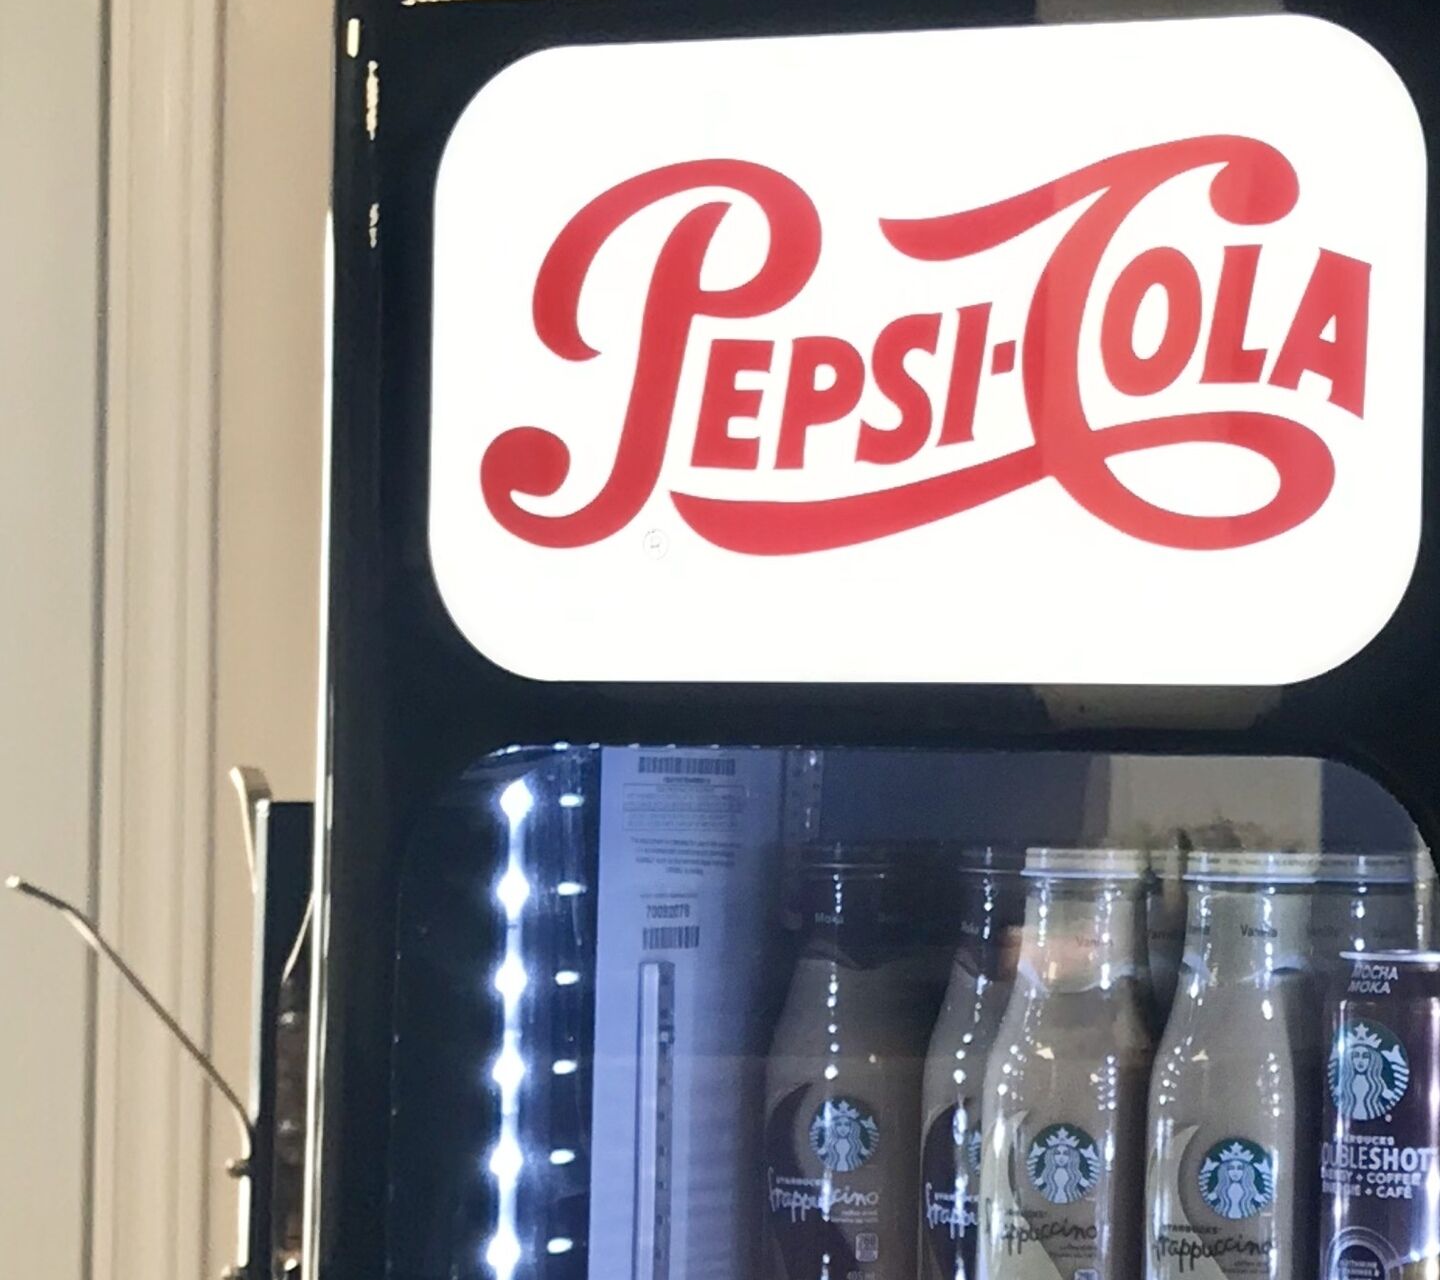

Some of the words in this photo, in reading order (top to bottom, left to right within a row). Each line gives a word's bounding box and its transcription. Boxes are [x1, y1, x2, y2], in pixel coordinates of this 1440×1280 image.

[1352, 962, 1398, 980] MOCHA
[1348, 981, 1391, 994] MOKA
[1321, 1142, 1438, 1173] OUBLESHOT
